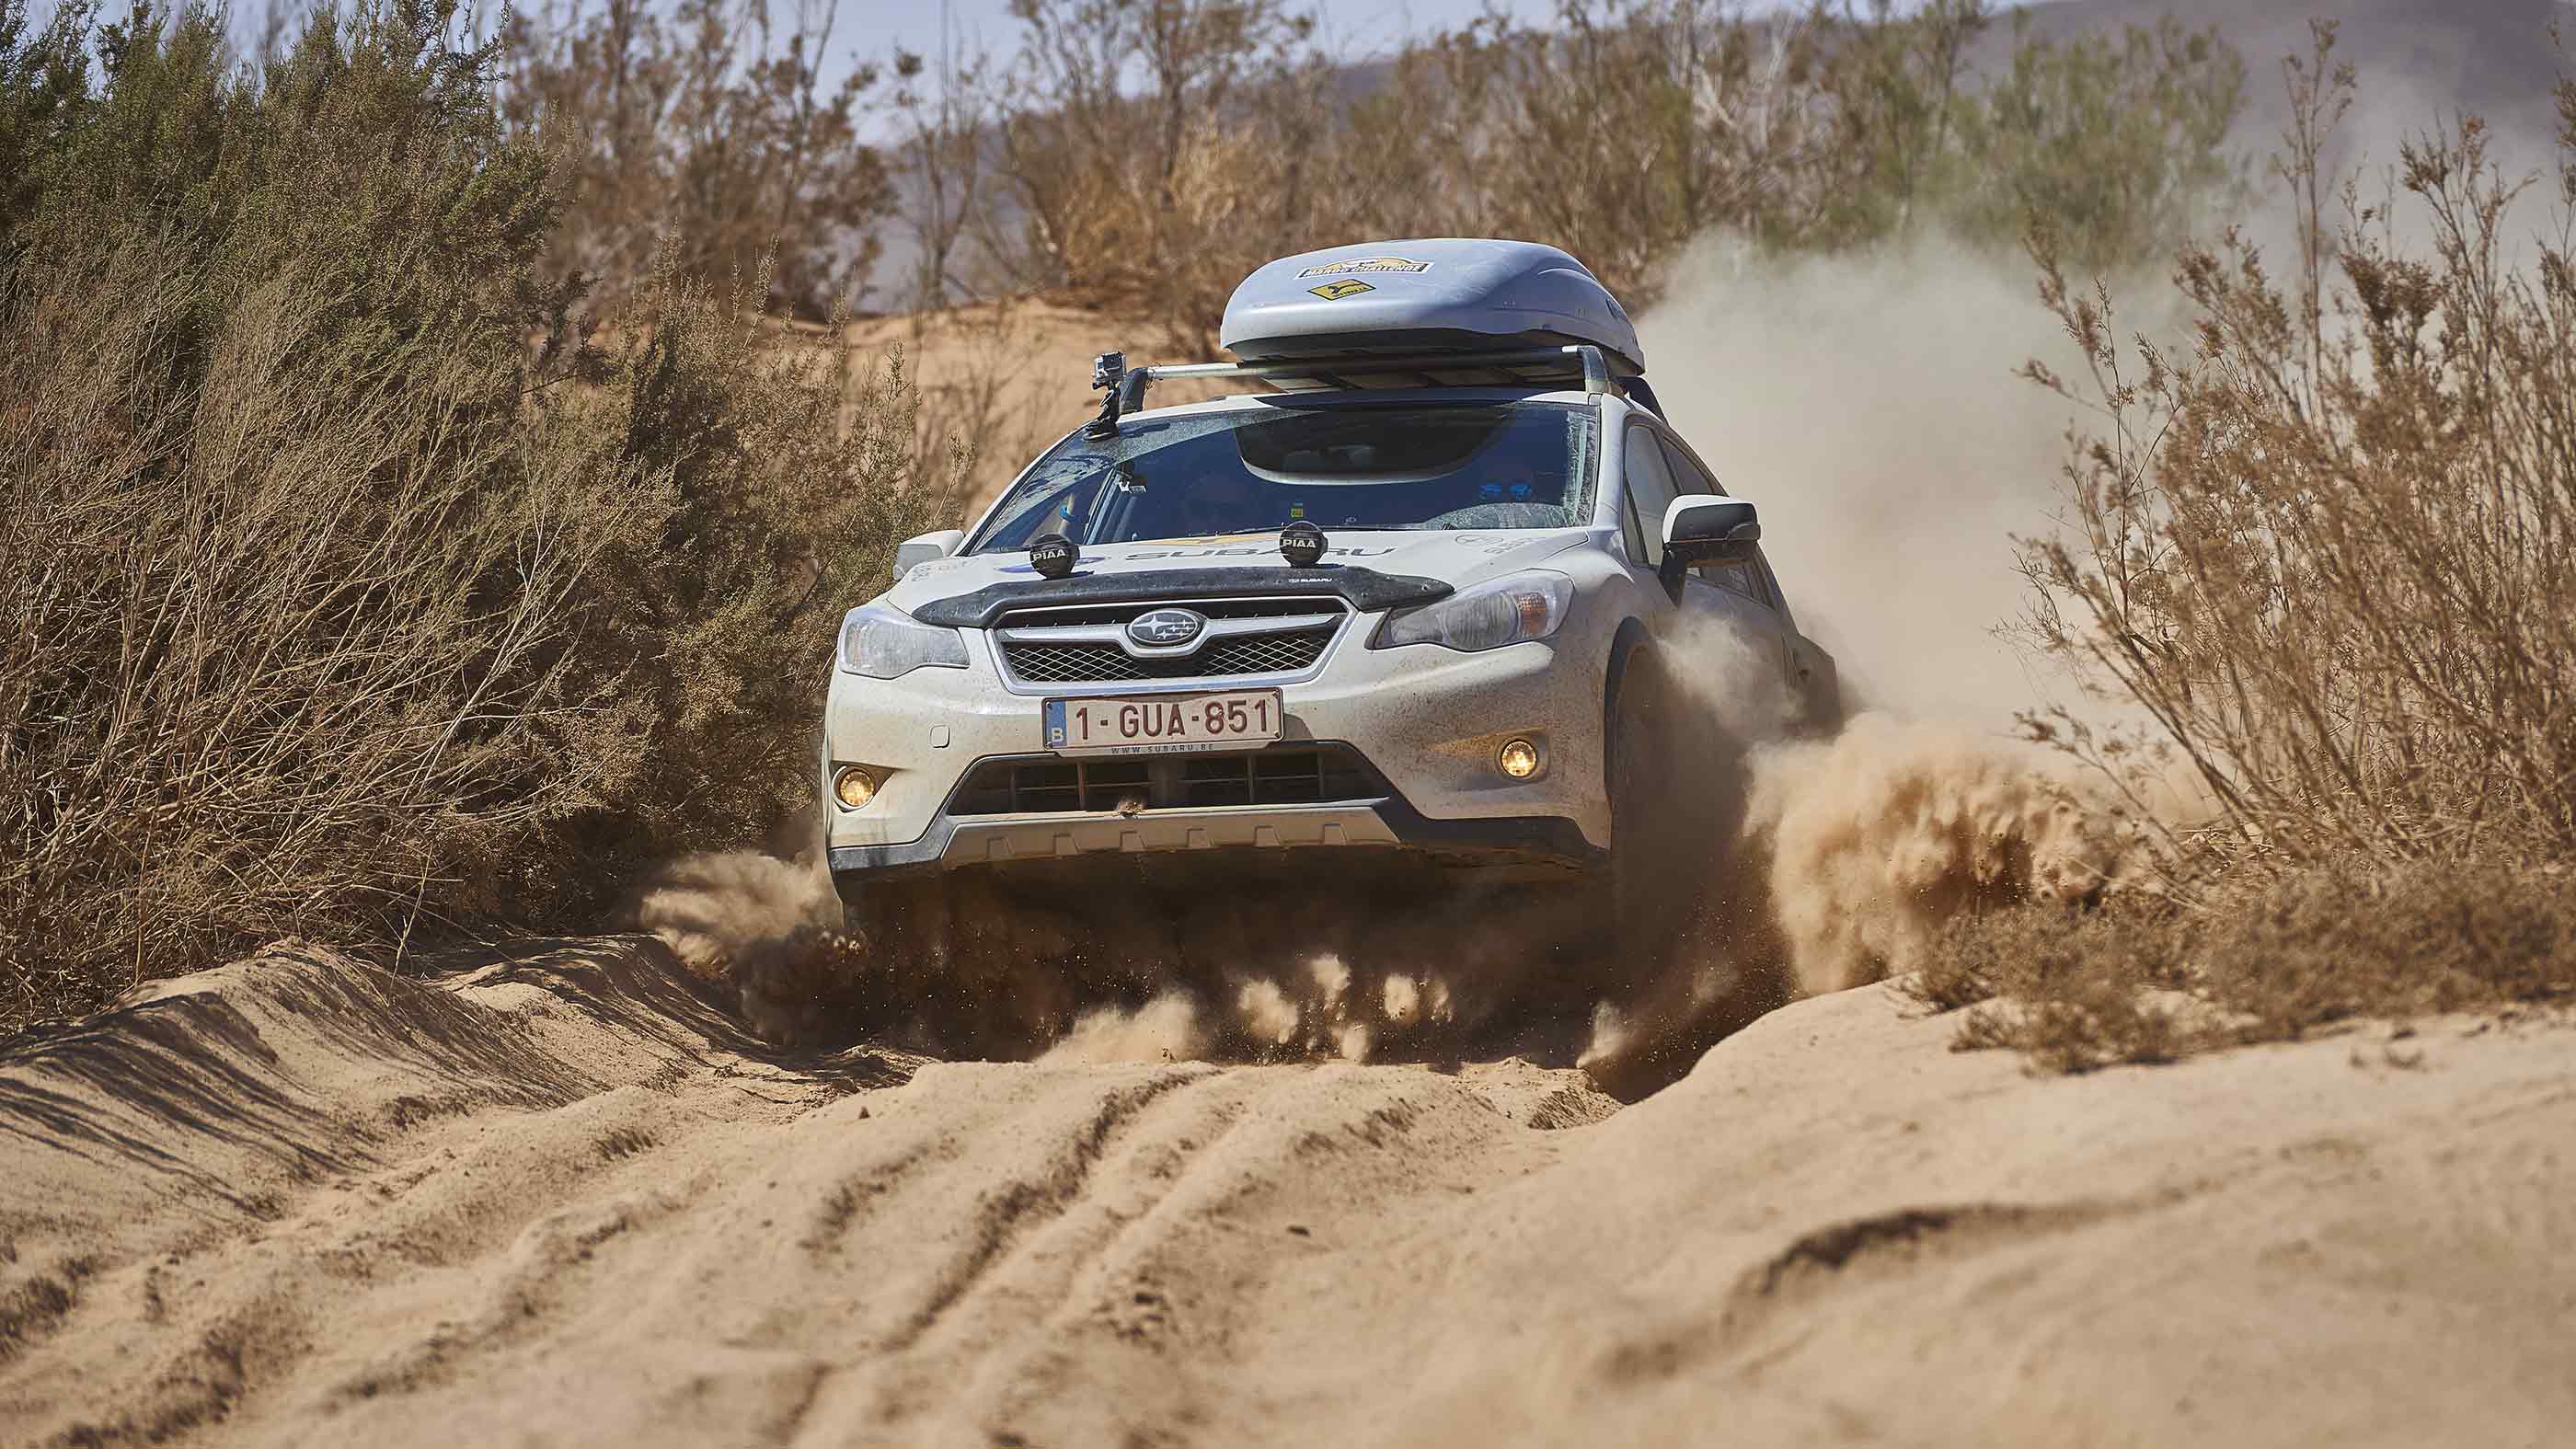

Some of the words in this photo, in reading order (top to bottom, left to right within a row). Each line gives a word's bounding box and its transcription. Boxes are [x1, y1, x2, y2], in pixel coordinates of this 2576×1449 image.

[1282, 538, 1317, 548] PIAA
[1032, 548, 1066, 561] PIAA
[1052, 728, 1064, 742] B
